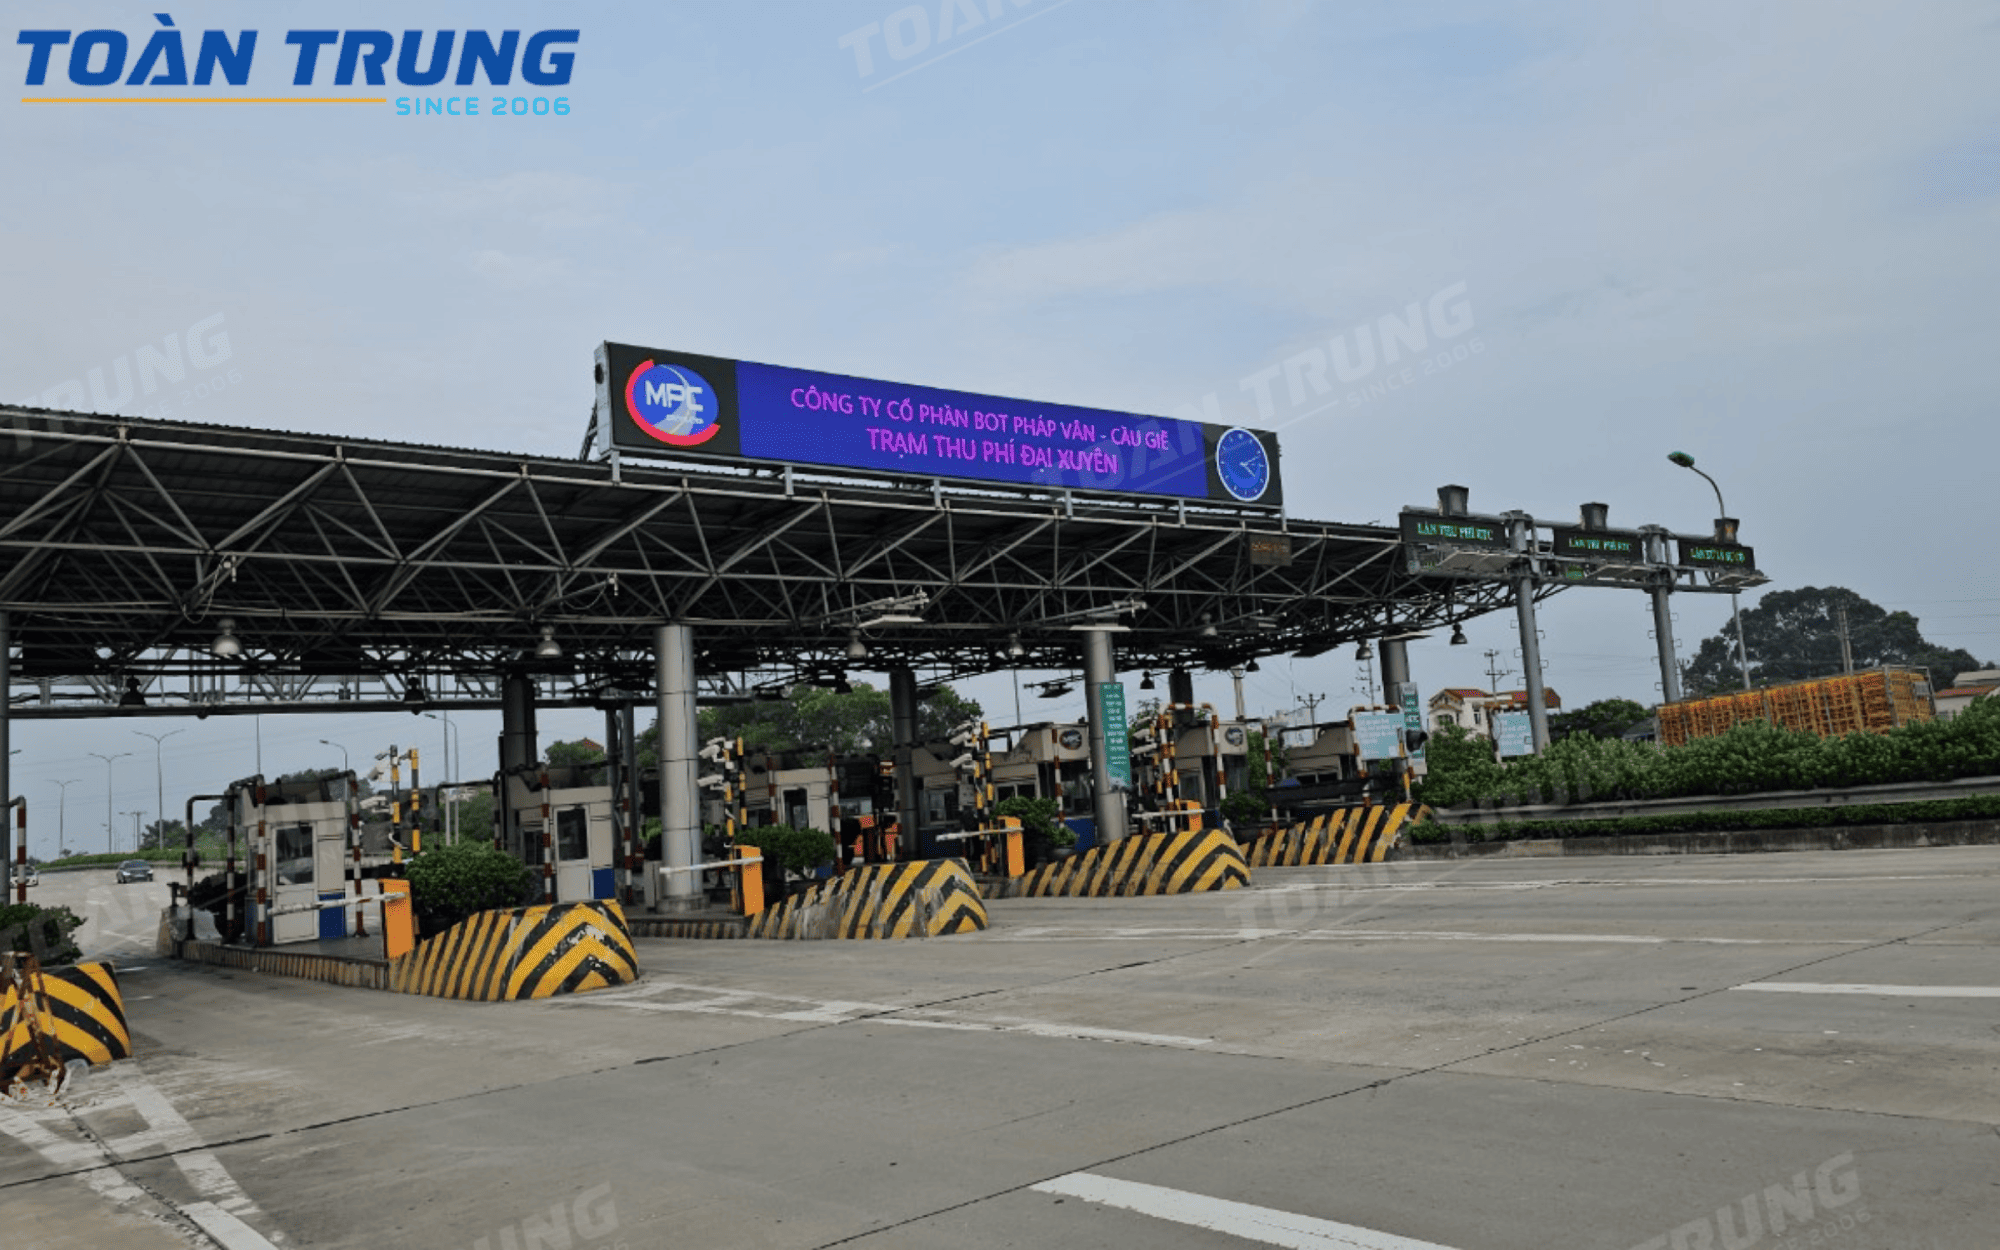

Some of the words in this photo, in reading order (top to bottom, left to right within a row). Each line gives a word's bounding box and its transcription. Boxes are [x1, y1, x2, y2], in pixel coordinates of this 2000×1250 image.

[645, 380, 704, 408] MPC
[791, 385, 853, 414] CÔNG
[858, 396, 881, 417] TY
[974, 411, 1008, 432] BOT
[1013, 415, 1056, 437] PHÁP
[1060, 420, 1096, 442] VÂN
[866, 428, 928, 459] TRẠM
[933, 434, 976, 460] THU
[983, 438, 1015, 464] PHÍ
[1021, 444, 1053, 473] ĐẠI
[1057, 447, 1118, 475] XUYÊN
